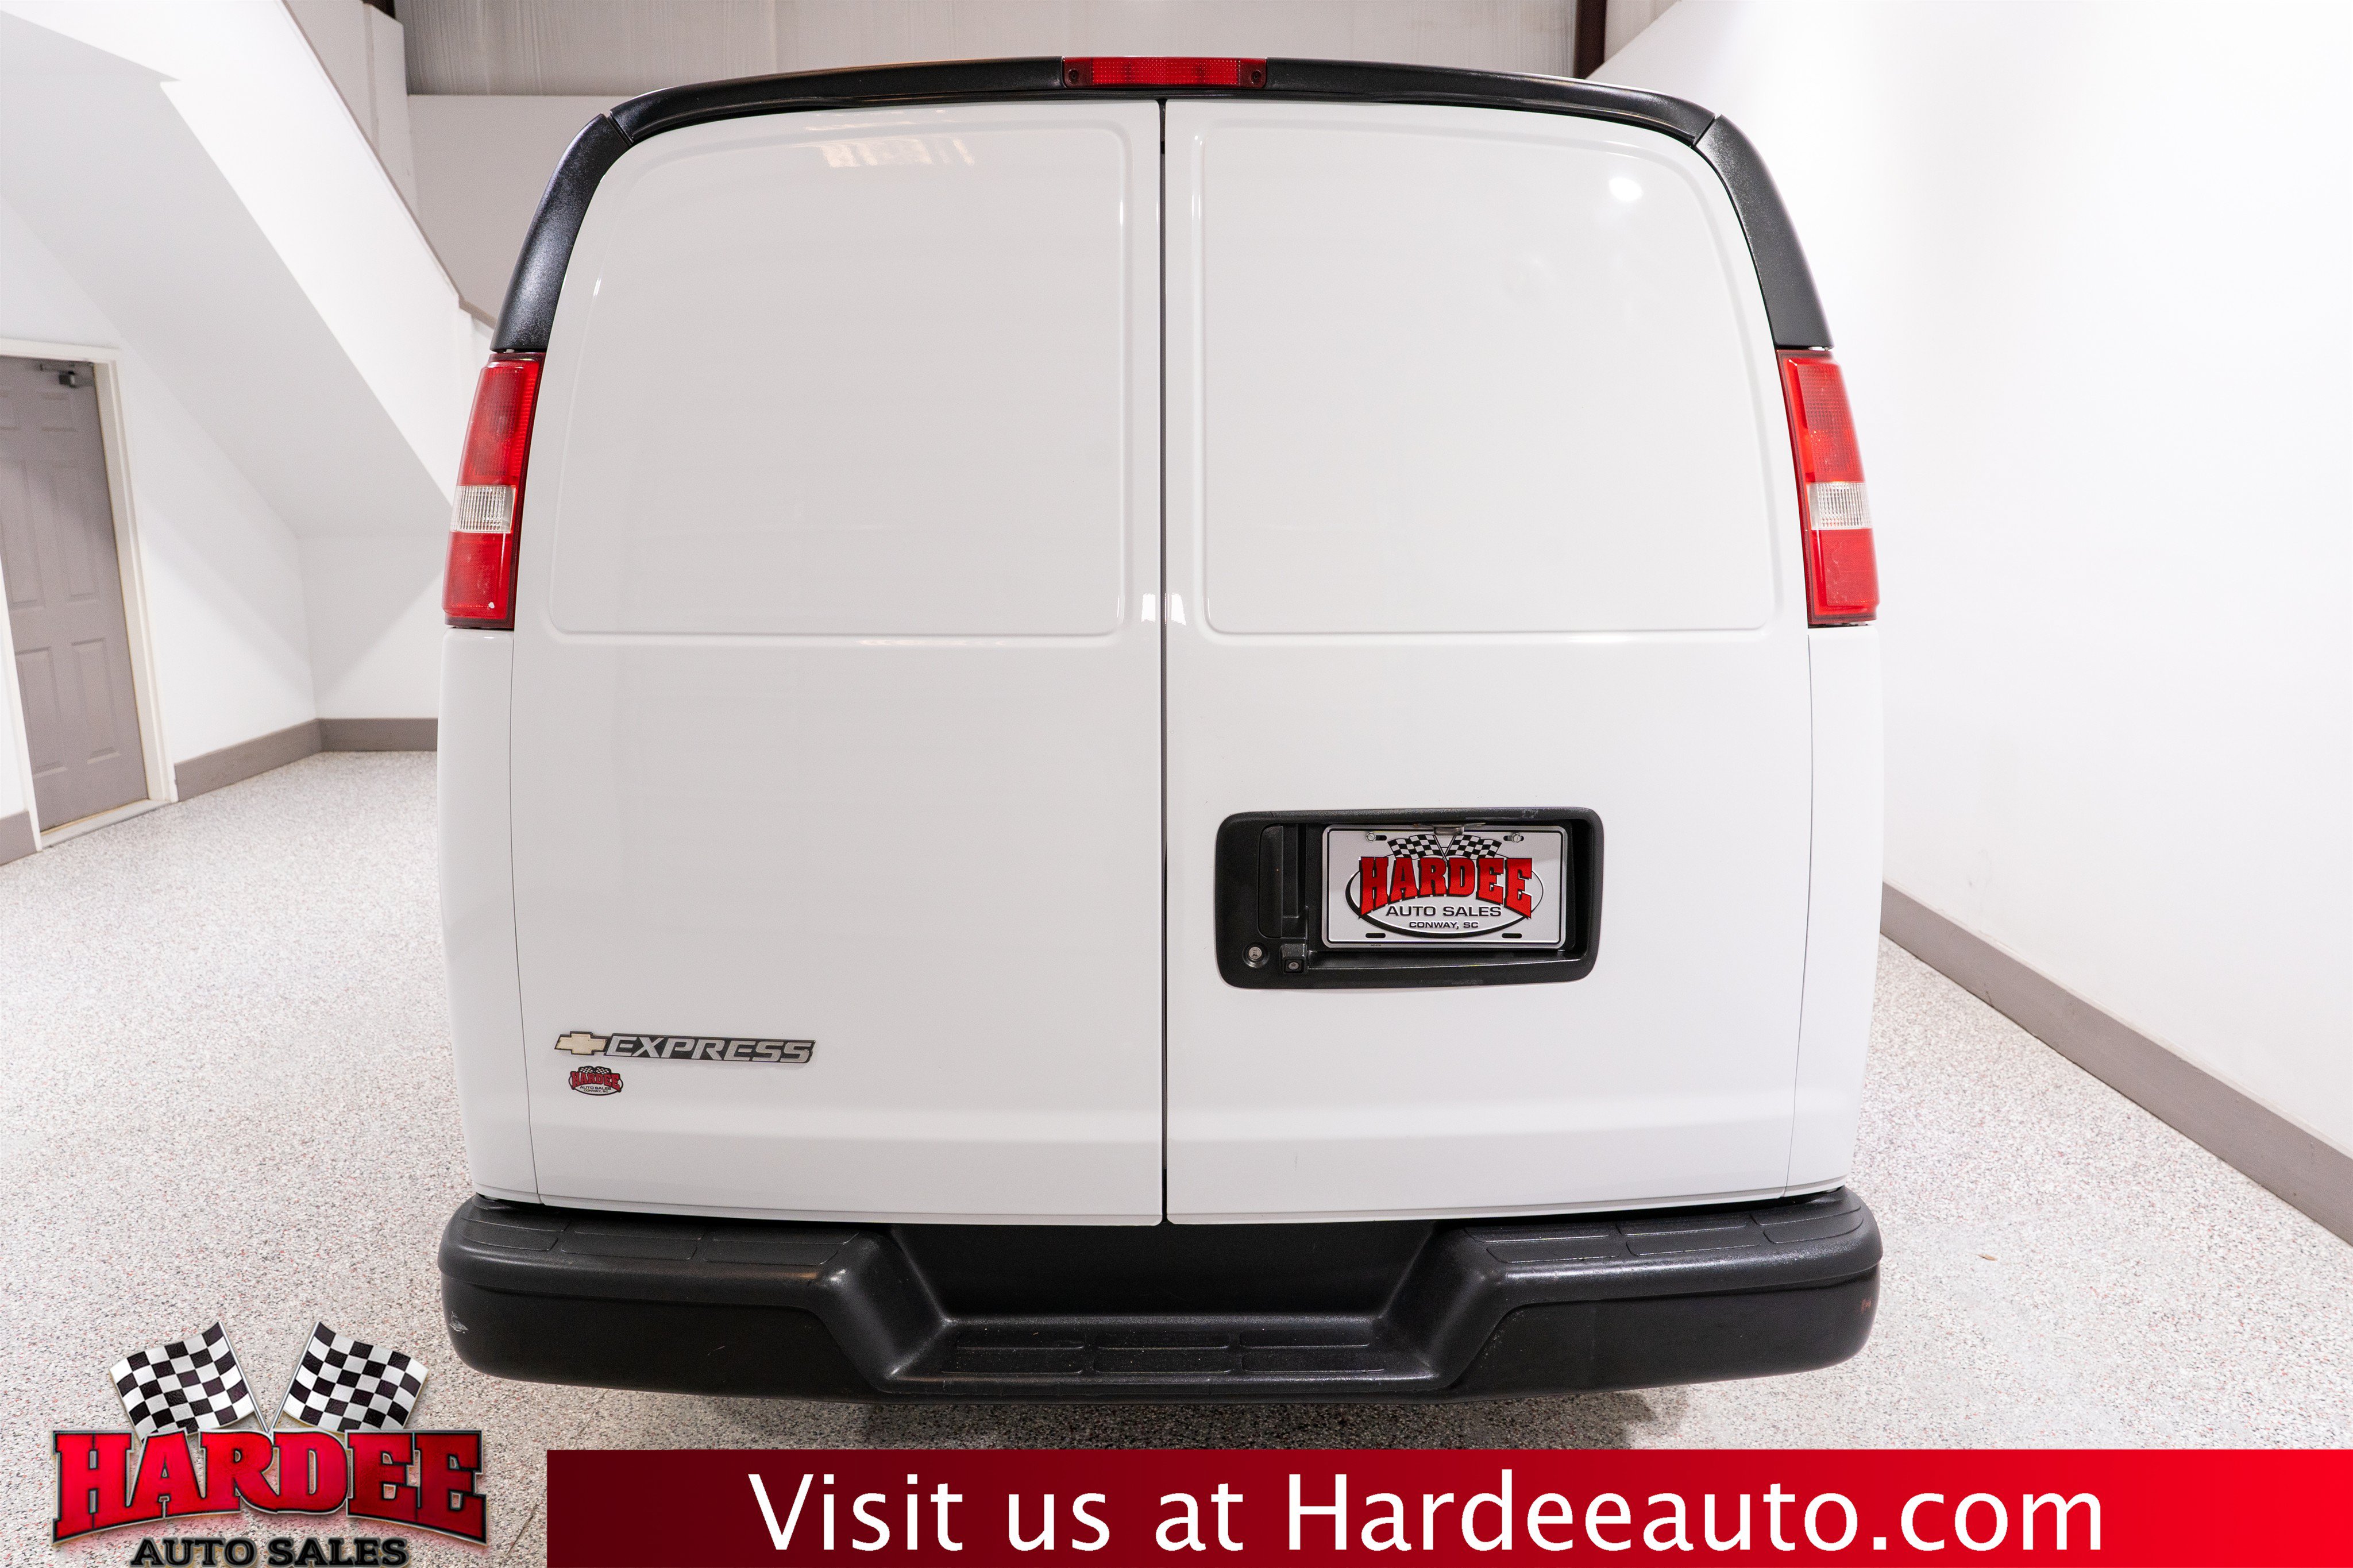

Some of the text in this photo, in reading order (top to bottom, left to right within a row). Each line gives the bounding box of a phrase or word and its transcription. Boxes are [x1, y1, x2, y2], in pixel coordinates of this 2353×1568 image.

[1359, 856, 1533, 918] HARDEE
[1386, 905, 1502, 917] AUTO SALES
[1409, 921, 1459, 929] CONWAY,
[605, 1034, 812, 1063] EXPRESS
[571, 1071, 621, 1091] HARDEE
